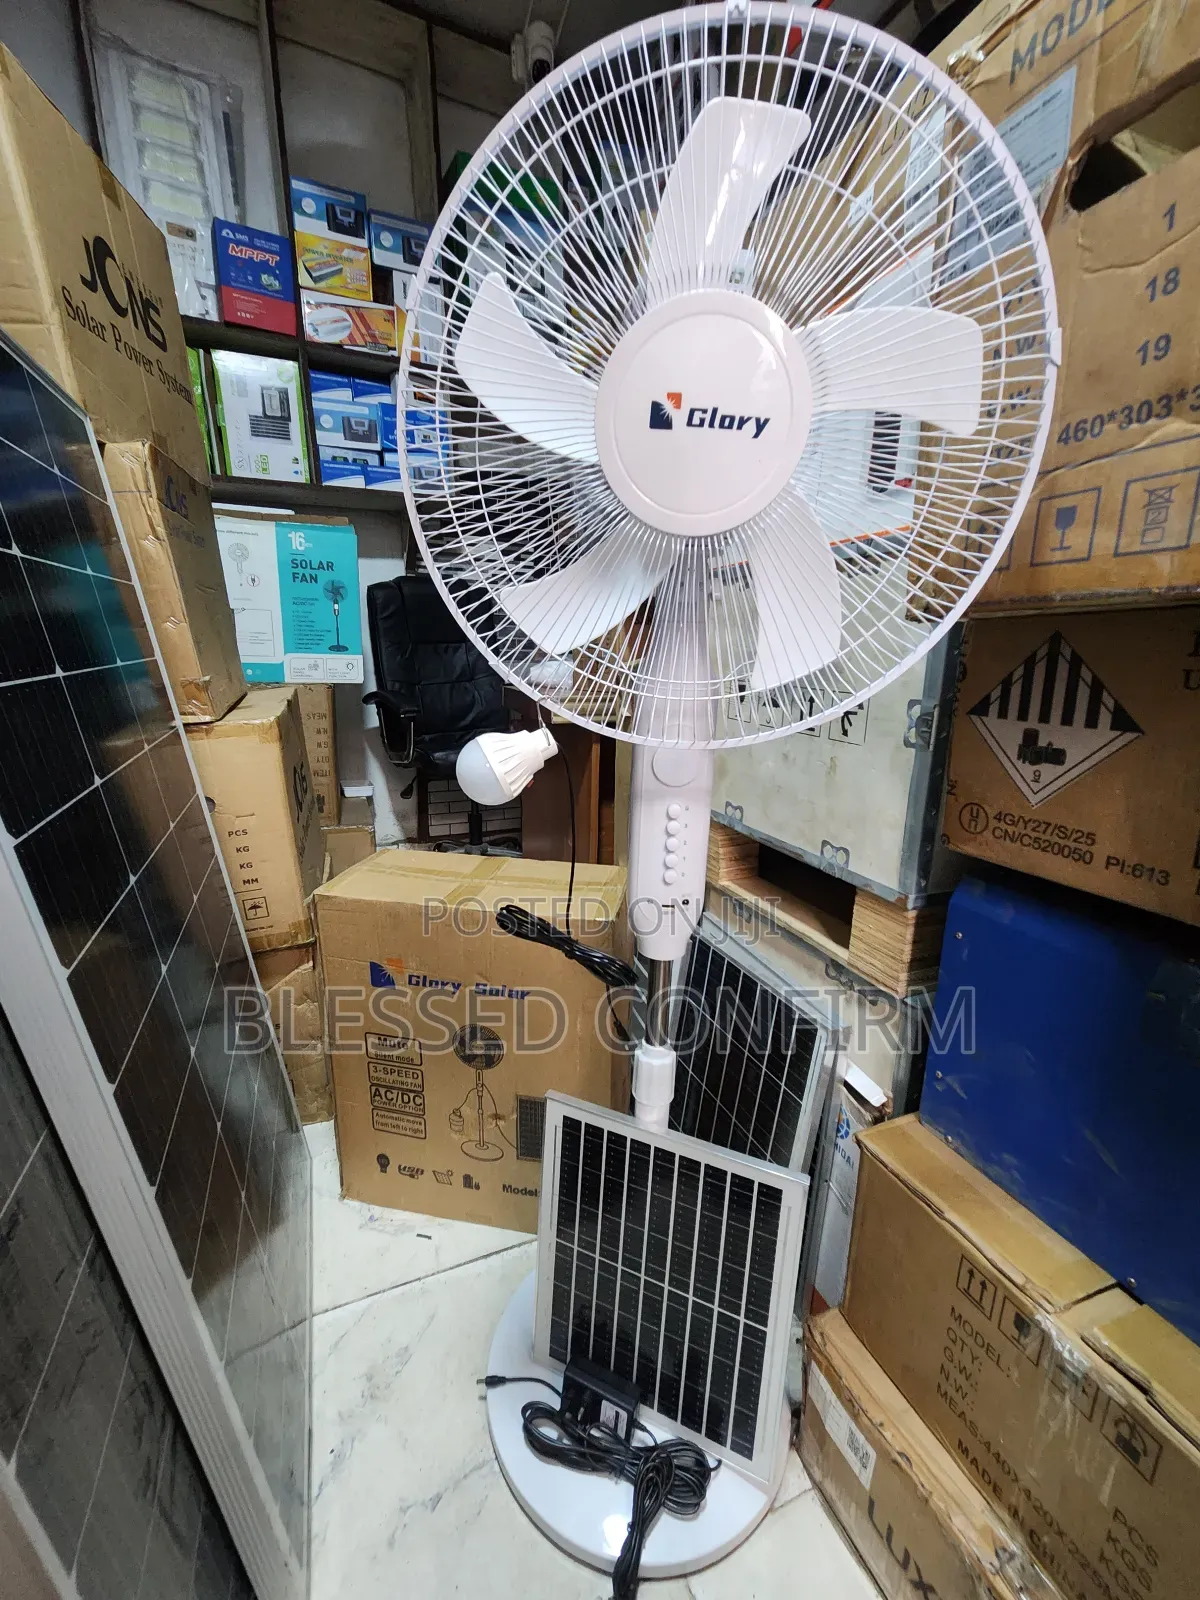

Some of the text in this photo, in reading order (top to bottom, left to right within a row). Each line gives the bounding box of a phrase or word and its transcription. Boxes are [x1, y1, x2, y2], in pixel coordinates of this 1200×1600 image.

[228, 243, 280, 267] MPPT
[1145, 266, 1181, 303] 18
[62, 285, 108, 343] Solar
[110, 321, 155, 377] Power
[156, 359, 194, 406] System
[1136, 333, 1172, 367] 19
[685, 406, 771, 439] Glory
[290, 558, 335, 572] SOLAR
[291, 572, 319, 585] FAN
[227, 828, 249, 838] PCS
[993, 810, 1097, 847] 4G/Y27/S/25
[235, 845, 250, 854] KG
[991, 826, 1094, 865] CN/C520050
[1104, 855, 1172, 887] PI:613
[239, 861, 253, 870] KG
[242, 877, 259, 886] MM
[407, 973, 532, 1001] Glory Solar
[377, 1036, 409, 1050] Mute
[395, 1054, 415, 1064] mode
[372, 1065, 420, 1081] 3-SPEED
[371, 1075, 422, 1089] OSCILLATING FAN
[372, 1087, 423, 1107] AC/DC
[372, 1099, 424, 1113] POWER OPTION
[375, 1111, 423, 1126] Automatic move
[375, 1120, 389, 1129] from
[390, 1122, 401, 1130] left
[408, 1125, 424, 1135] right
[957, 1437, 1004, 1501] MADE
[1112, 1506, 1159, 1567] PCS
[1106, 1528, 1152, 1592] KGS
